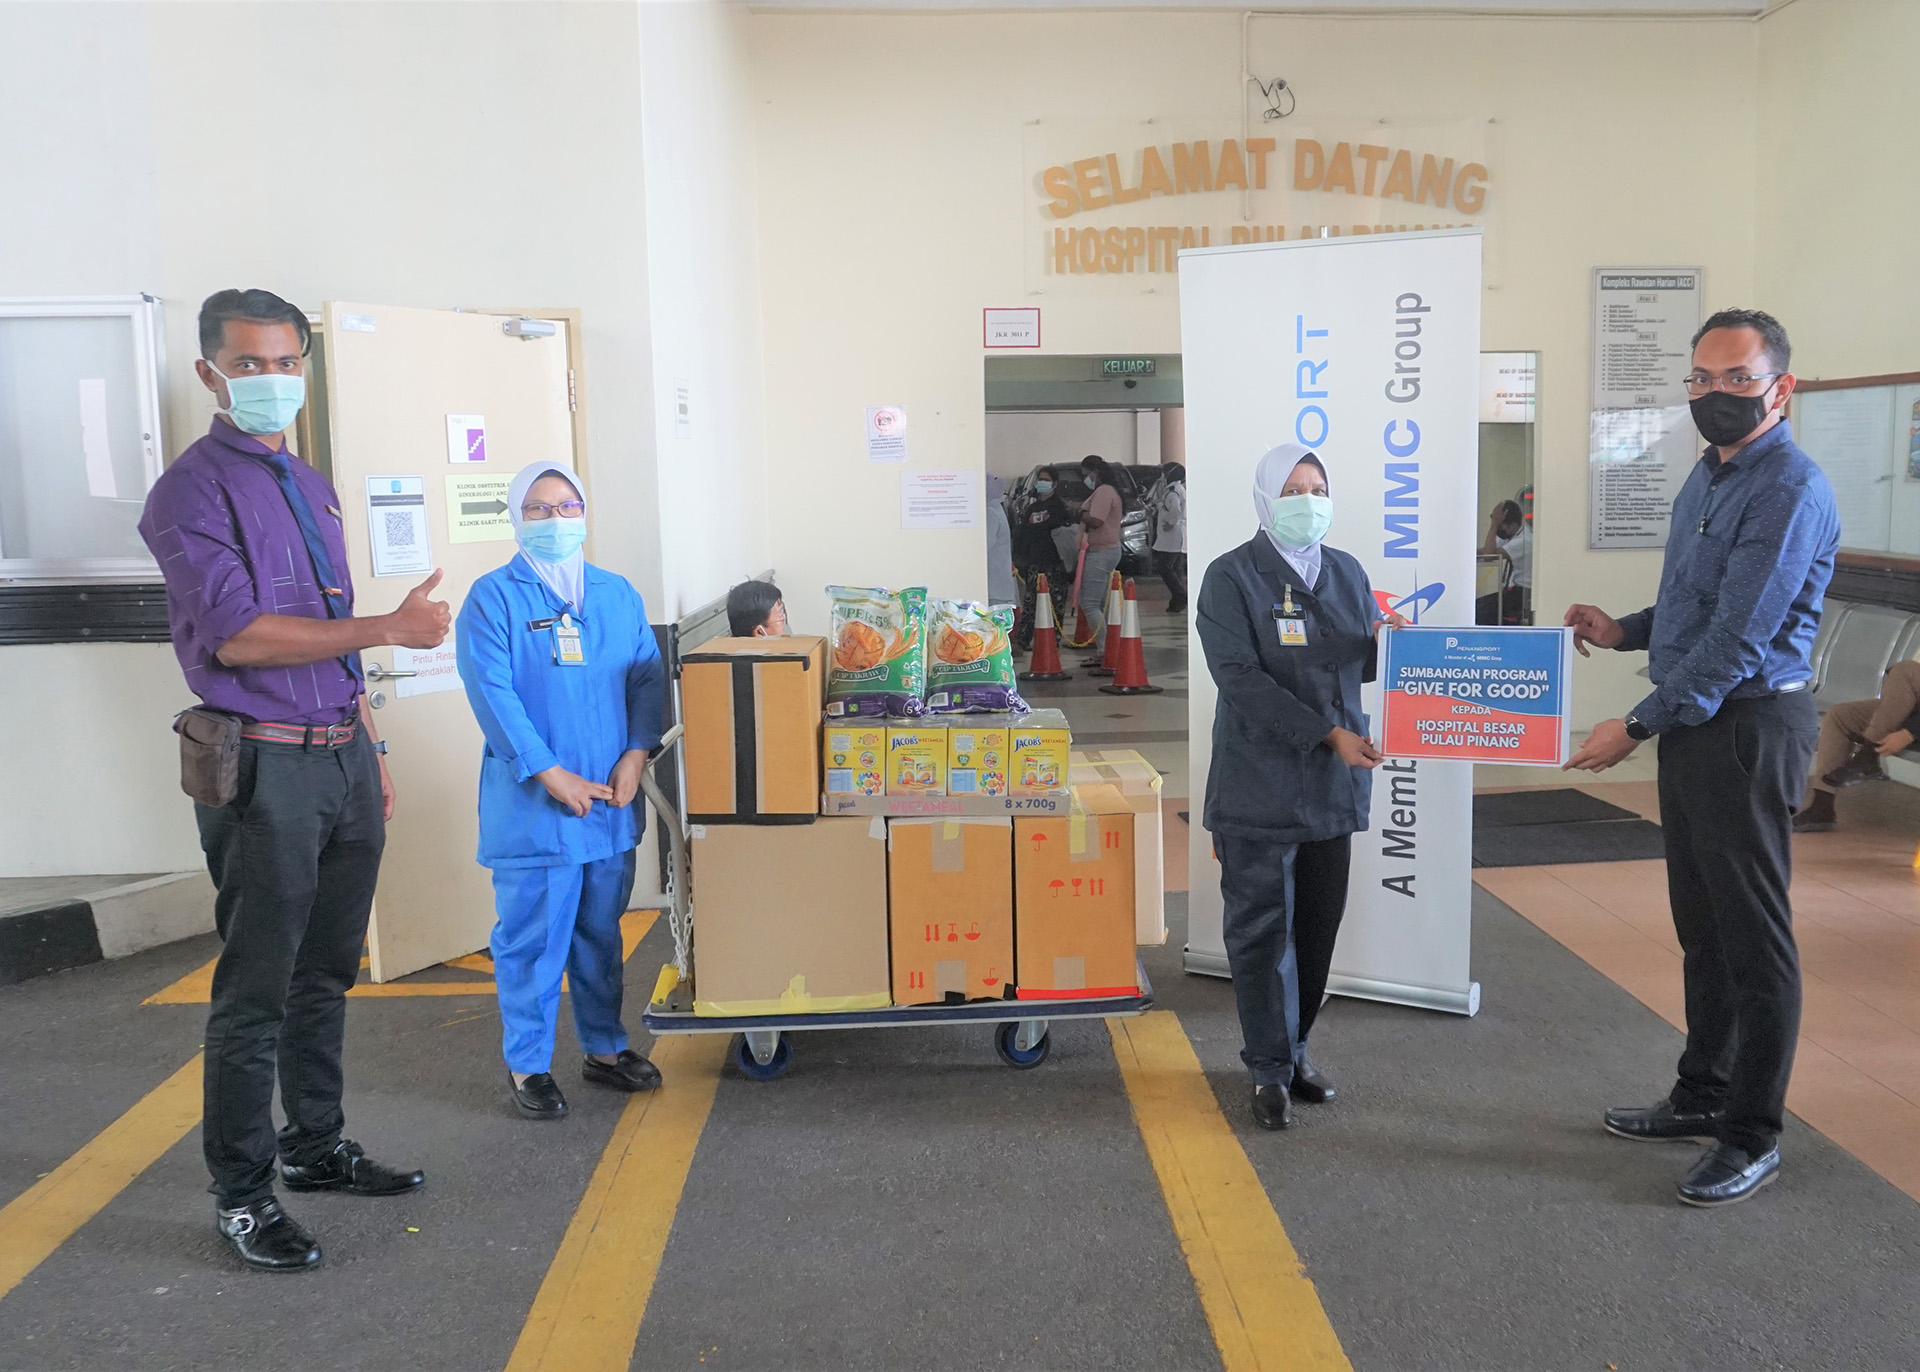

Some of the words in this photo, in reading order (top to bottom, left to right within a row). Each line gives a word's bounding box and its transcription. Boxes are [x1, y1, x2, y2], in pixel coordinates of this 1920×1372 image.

[1043, 137, 1276, 219] SELAMAT
[1294, 138, 1489, 215] DATANG
[1603, 277, 1630, 288] Kompleks
[1631, 278, 1656, 288] Rawatan
[1657, 278, 1676, 288] Harian
[1384, 292, 1431, 404] Group
[1104, 360, 1144, 373] KELUAR
[1295, 314, 1329, 448] ORT
[1383, 418, 1421, 559] MMC
[876, 616, 892, 630] 5%
[412, 655, 432, 665] Pintu
[436, 652, 456, 662] Rinta
[1400, 666, 1480, 680] SUMBANGAN
[1483, 669, 1548, 681] PROGRAM
[1397, 680, 1444, 696] "GIVE
[1448, 682, 1483, 698] FOR
[1486, 684, 1550, 699] GOOD"
[1452, 706, 1492, 715] KEPADA
[1416, 720, 1480, 733] HOSPITAL
[1483, 722, 1526, 735] BESAR
[890, 734, 919, 752] JACOB'S
[1014, 735, 1042, 753] JACOB'S
[1421, 733, 1464, 746] PULAU
[1467, 735, 1520, 748] PINANG
[888, 800, 965, 813] WEETAMEAL
[1004, 799, 1012, 808] 8
[1026, 799, 1056, 810] 700g
[1381, 759, 1417, 860] Memb
[1381, 874, 1416, 899] A
